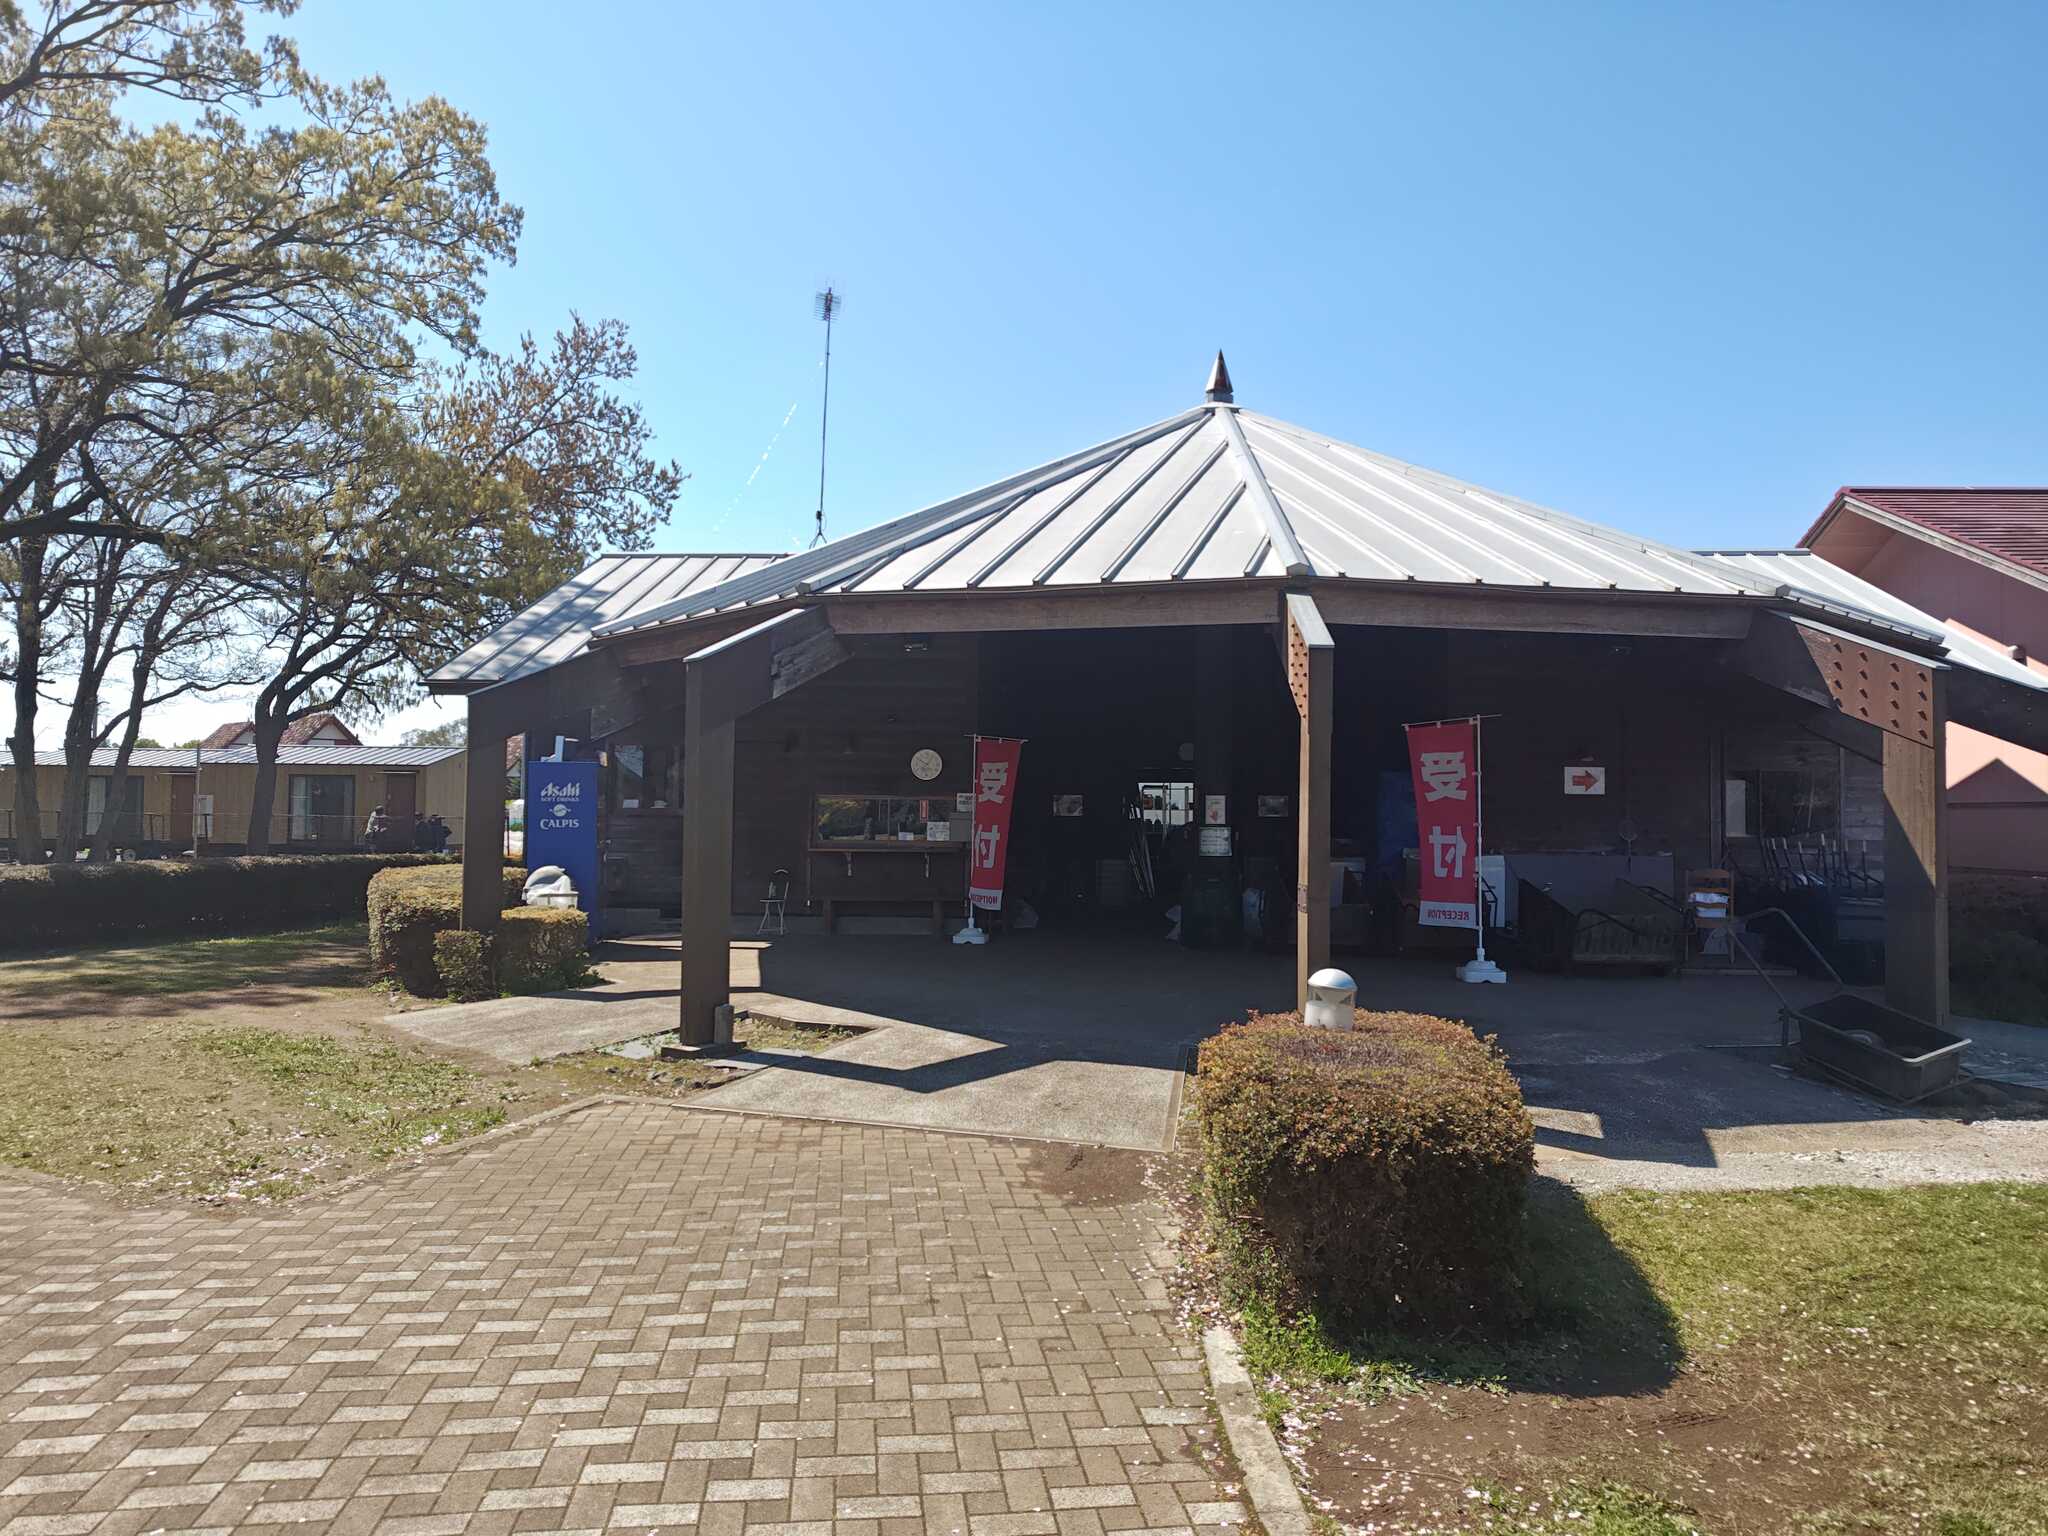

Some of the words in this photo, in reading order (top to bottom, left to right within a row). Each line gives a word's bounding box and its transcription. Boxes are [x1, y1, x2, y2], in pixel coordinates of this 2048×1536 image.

[540, 782, 580, 797] Asahi
[974, 761, 1009, 869] 受付
[540, 818, 580, 830] CALPIS
